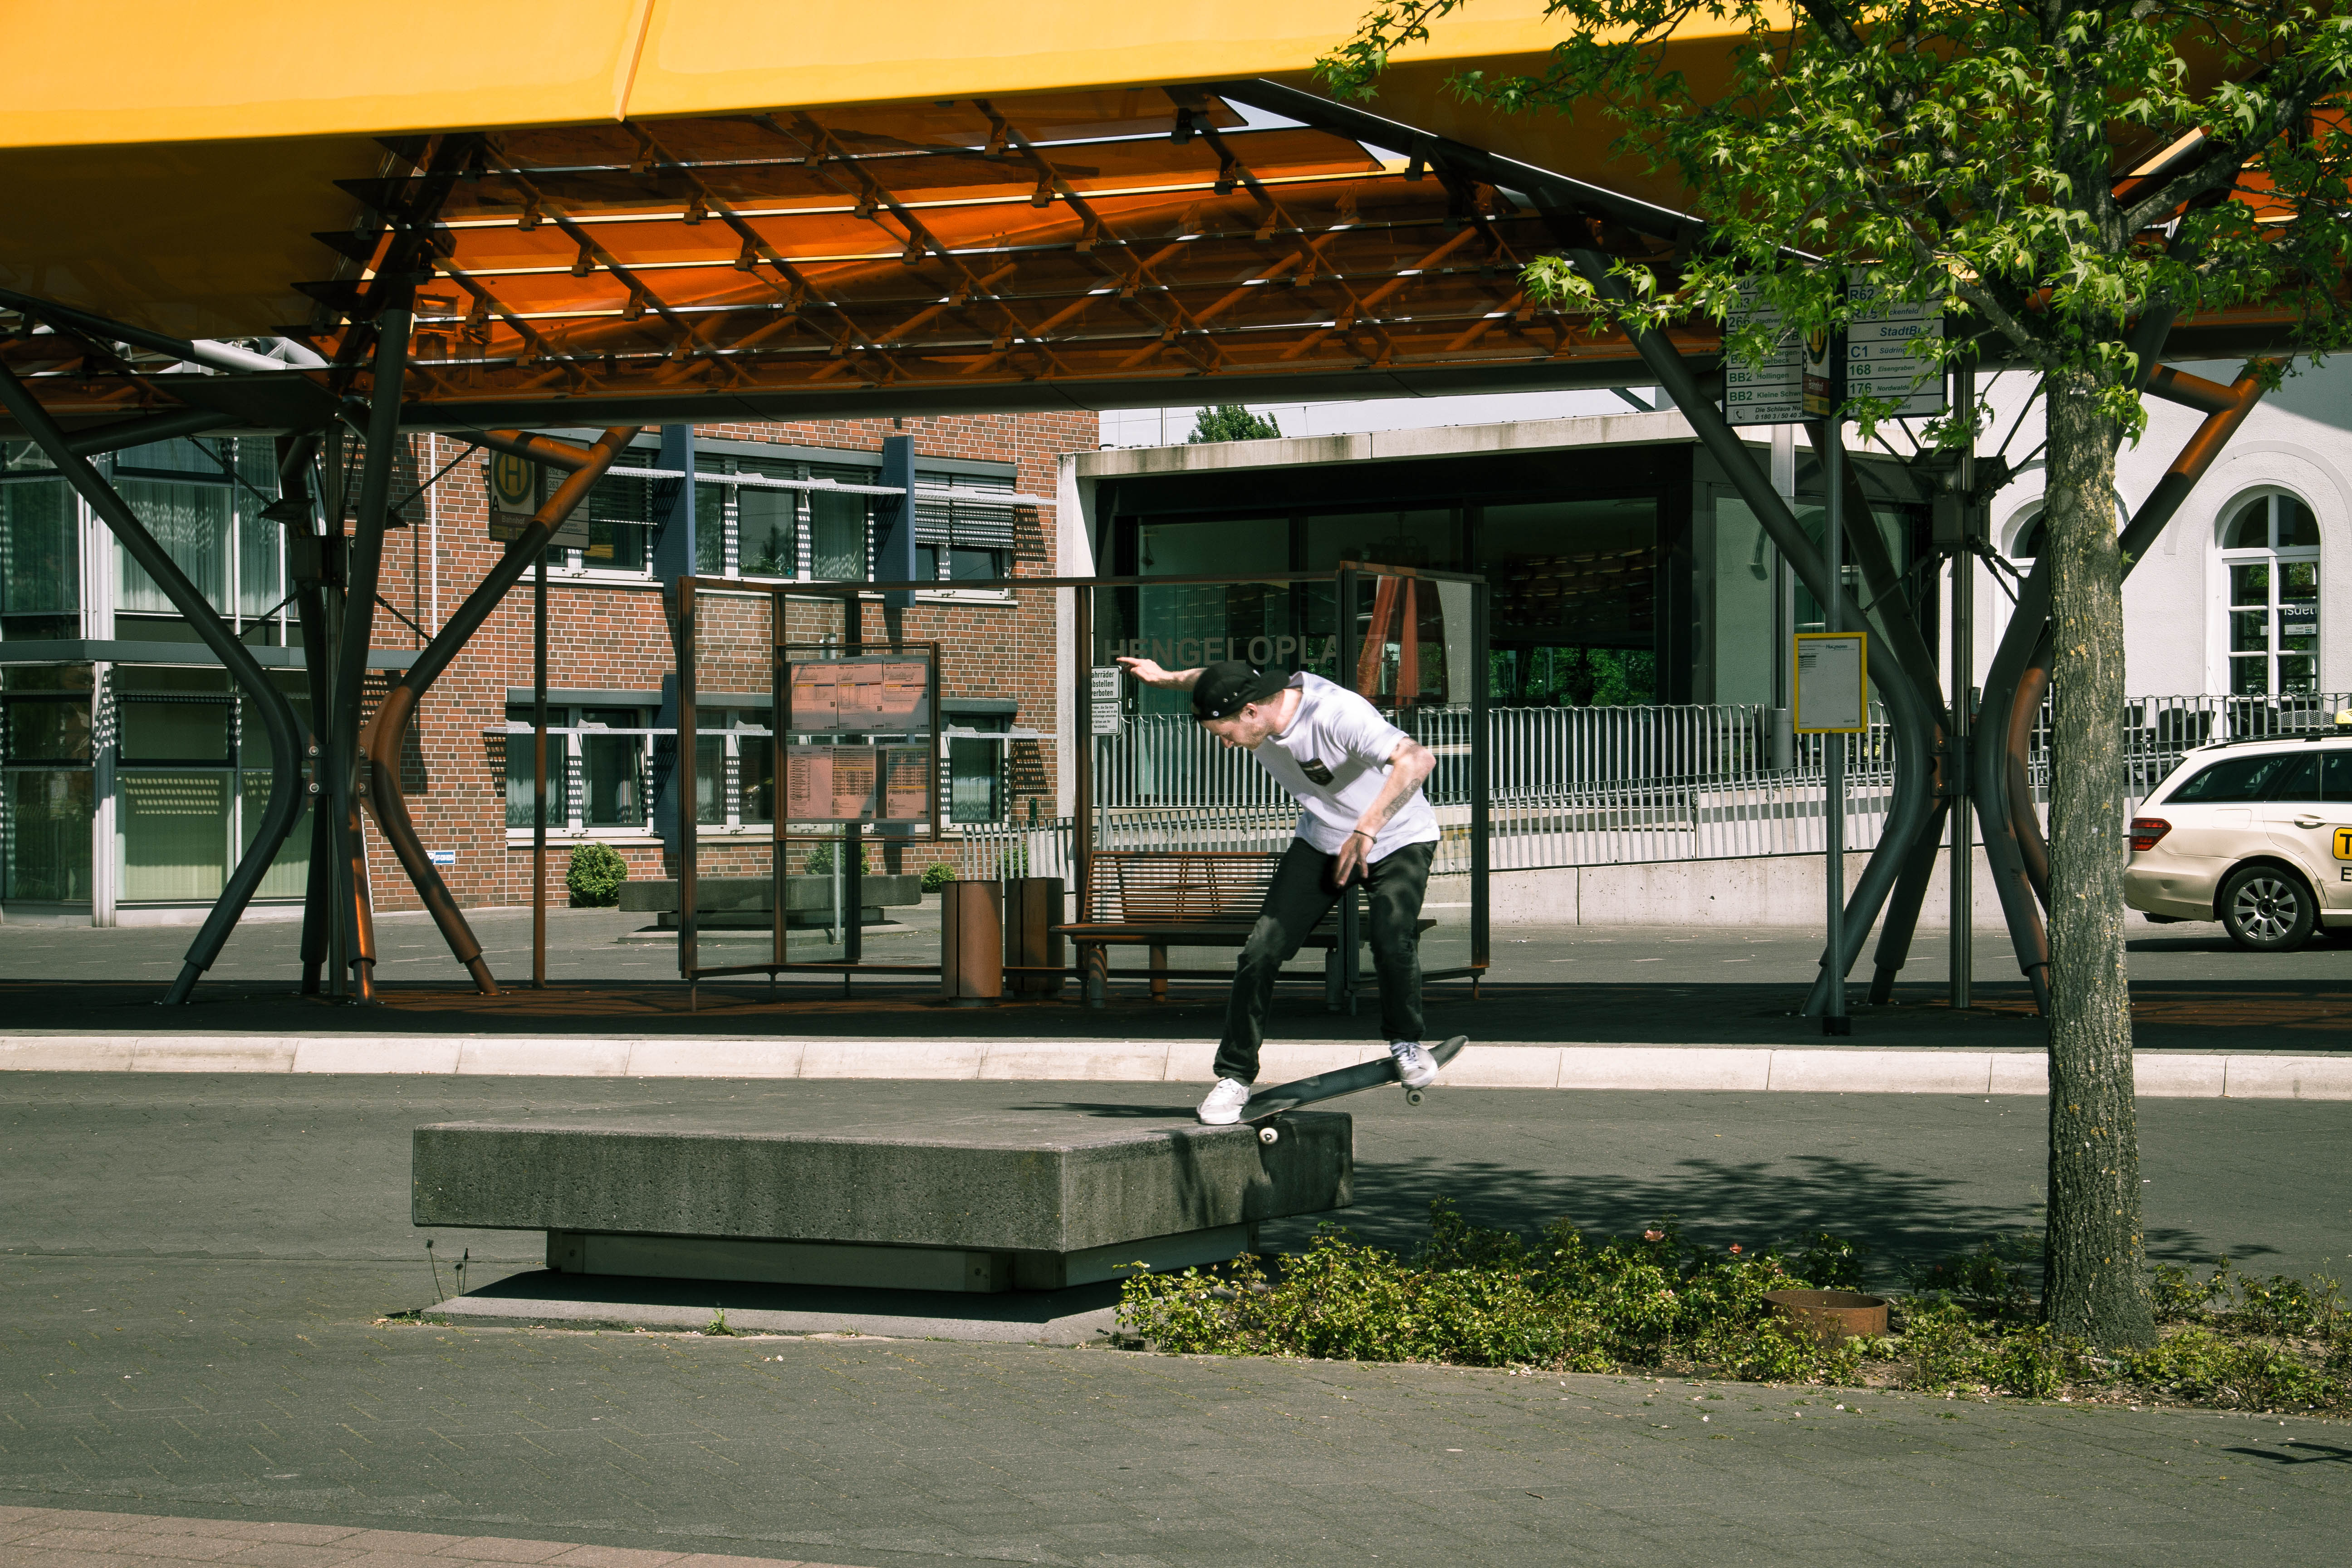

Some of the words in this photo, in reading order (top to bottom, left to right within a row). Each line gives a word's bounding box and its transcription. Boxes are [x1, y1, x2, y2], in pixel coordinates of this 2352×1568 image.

[1850, 289, 1874, 300] R62
[1851, 345, 1868, 358] C1
[1849, 364, 1871, 376] 168
[1729, 372, 1752, 382] BB2
[1850, 382, 1872, 394] 176
[1729, 391, 1753, 402] BB2
[549, 480, 559, 489] 263
[492, 495, 500, 511] A
[501, 515, 525, 525] Bahnhof
[2339, 833, 2352, 854] T
[2341, 867, 2352, 882] E
